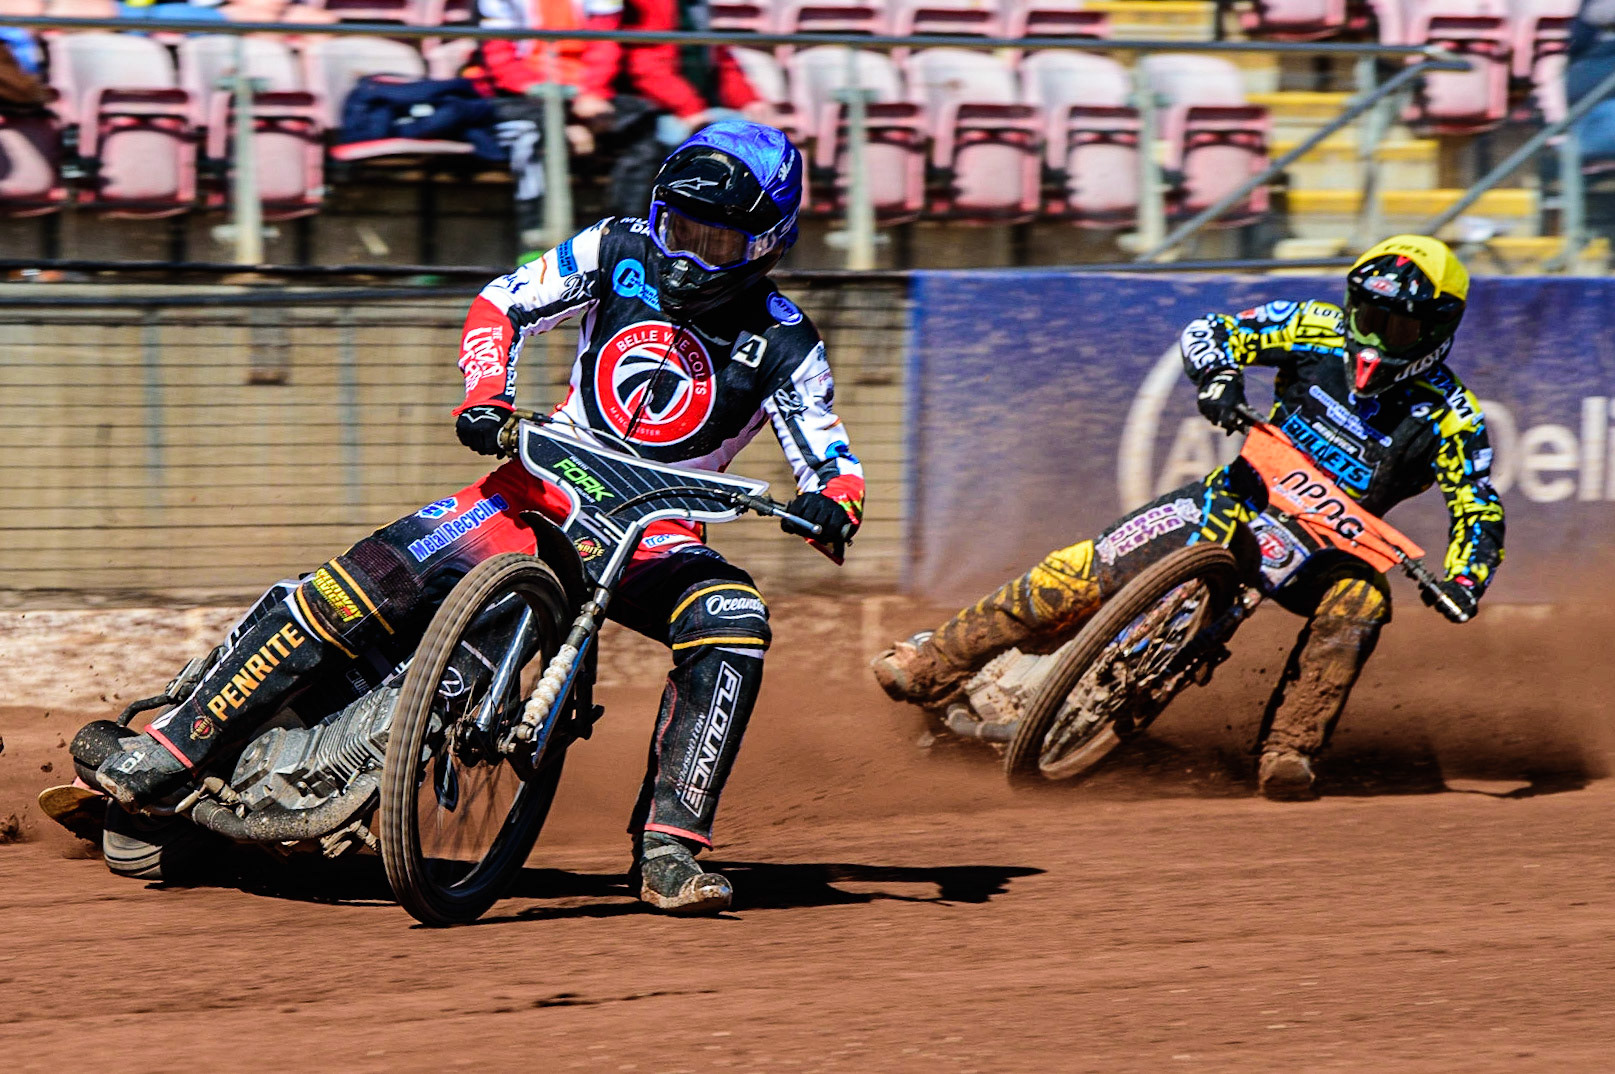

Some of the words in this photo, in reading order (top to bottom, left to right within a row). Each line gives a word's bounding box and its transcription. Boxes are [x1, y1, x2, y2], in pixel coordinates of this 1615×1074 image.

[616, 330, 658, 352] BELLE
[664, 331, 690, 351] VE
[688, 351, 707, 396] COLTS
[609, 406, 661, 436] MANCSTER
[1286, 422, 1370, 482] BULLETS
[553, 458, 615, 502] FORK
[408, 527, 453, 562] Metal
[442, 493, 509, 542] Recycling
[207, 622, 305, 722] PENRITE
